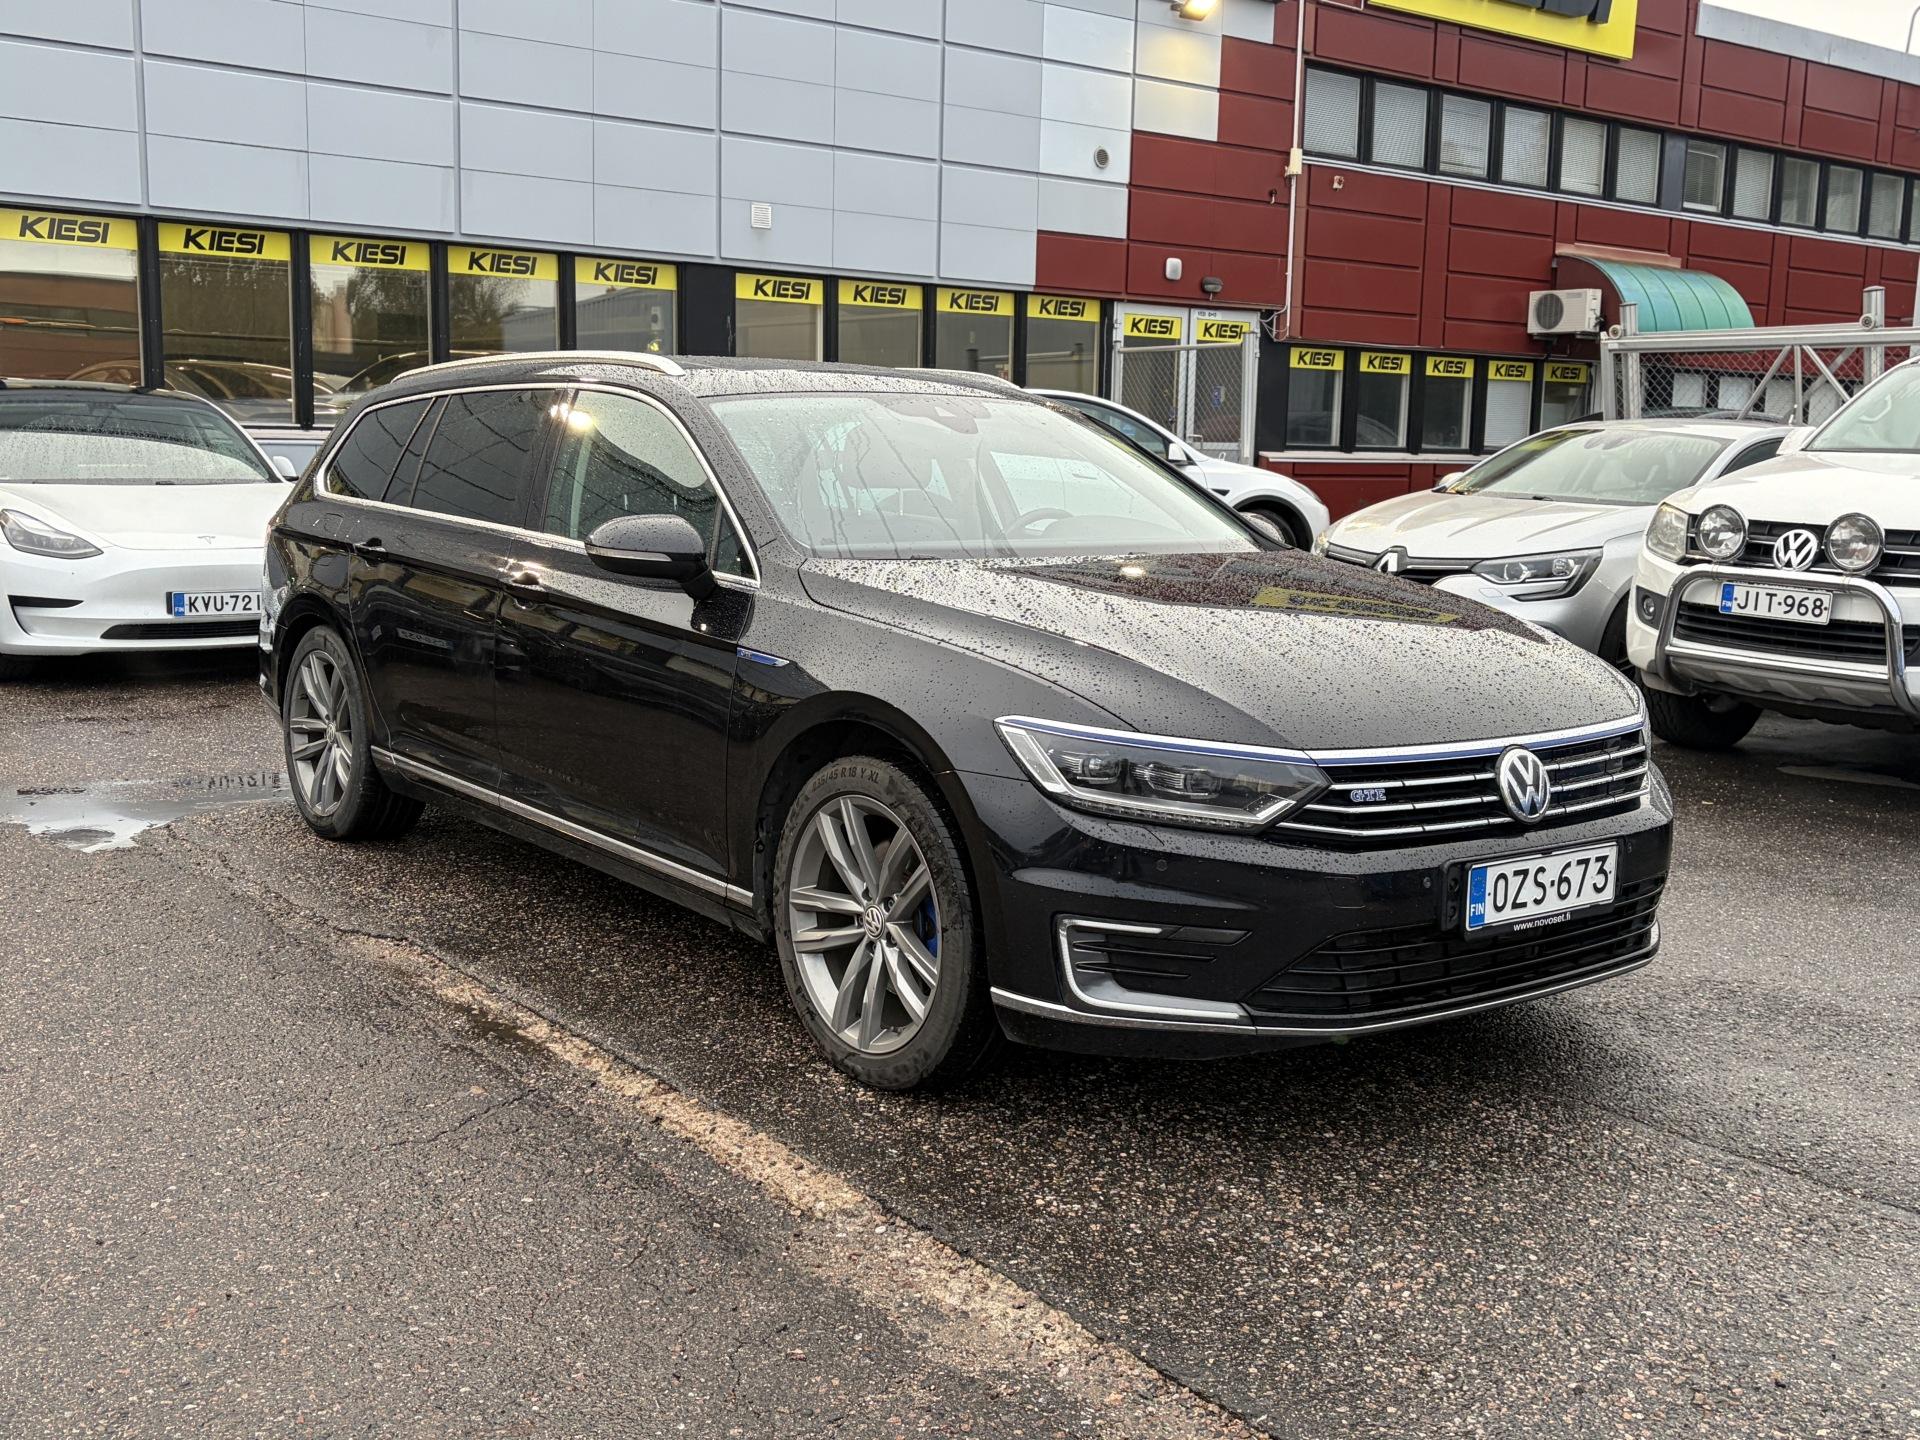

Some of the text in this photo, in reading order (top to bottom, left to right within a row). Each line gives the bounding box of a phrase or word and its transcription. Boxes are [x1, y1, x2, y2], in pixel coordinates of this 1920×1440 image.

[18, 216, 109, 243] KIESI
[183, 228, 264, 255] KIESI
[332, 241, 406, 266] KIESI
[468, 251, 537, 276] KIESI
[594, 262, 658, 285] KIESI
[754, 279, 810, 300] KIESI
[853, 285, 907, 305] KIESI
[949, 293, 999, 312] KIESI
[1039, 298, 1086, 317] KIESI
[1131, 318, 1174, 335] KIESI
[1203, 322, 1244, 339] KIESI
[1298, 351, 1336, 367] KIESI
[1367, 355, 1403, 371] KIESI
[1432, 360, 1467, 375] KIESI
[1495, 364, 1527, 379] KIESI
[1551, 367, 1581, 381] KIESI
[188, 595, 261, 612] KVU-721
[1737, 591, 1824, 618] JIT-968
[1350, 788, 1387, 802] GTE
[1492, 855, 1610, 913] OZS-673
[1470, 901, 1485, 917] FIN
[1513, 912, 1572, 931] www.novoset.fi
